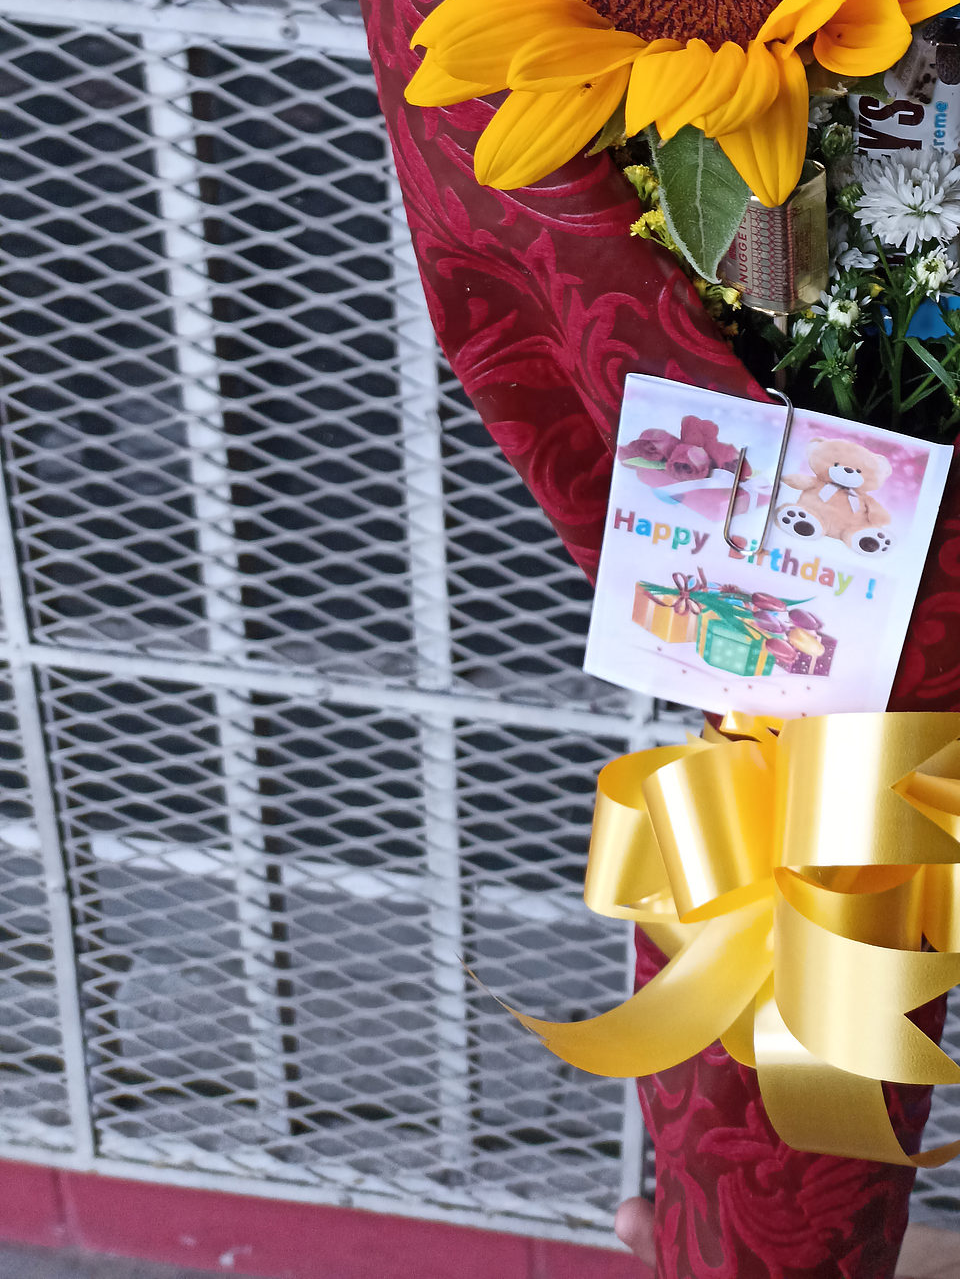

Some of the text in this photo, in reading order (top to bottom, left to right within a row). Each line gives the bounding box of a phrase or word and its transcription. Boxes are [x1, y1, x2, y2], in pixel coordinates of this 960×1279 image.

[858, 95, 925, 158] Y'S
[613, 507, 710, 555] Happy
[728, 534, 853, 597] Birthday
